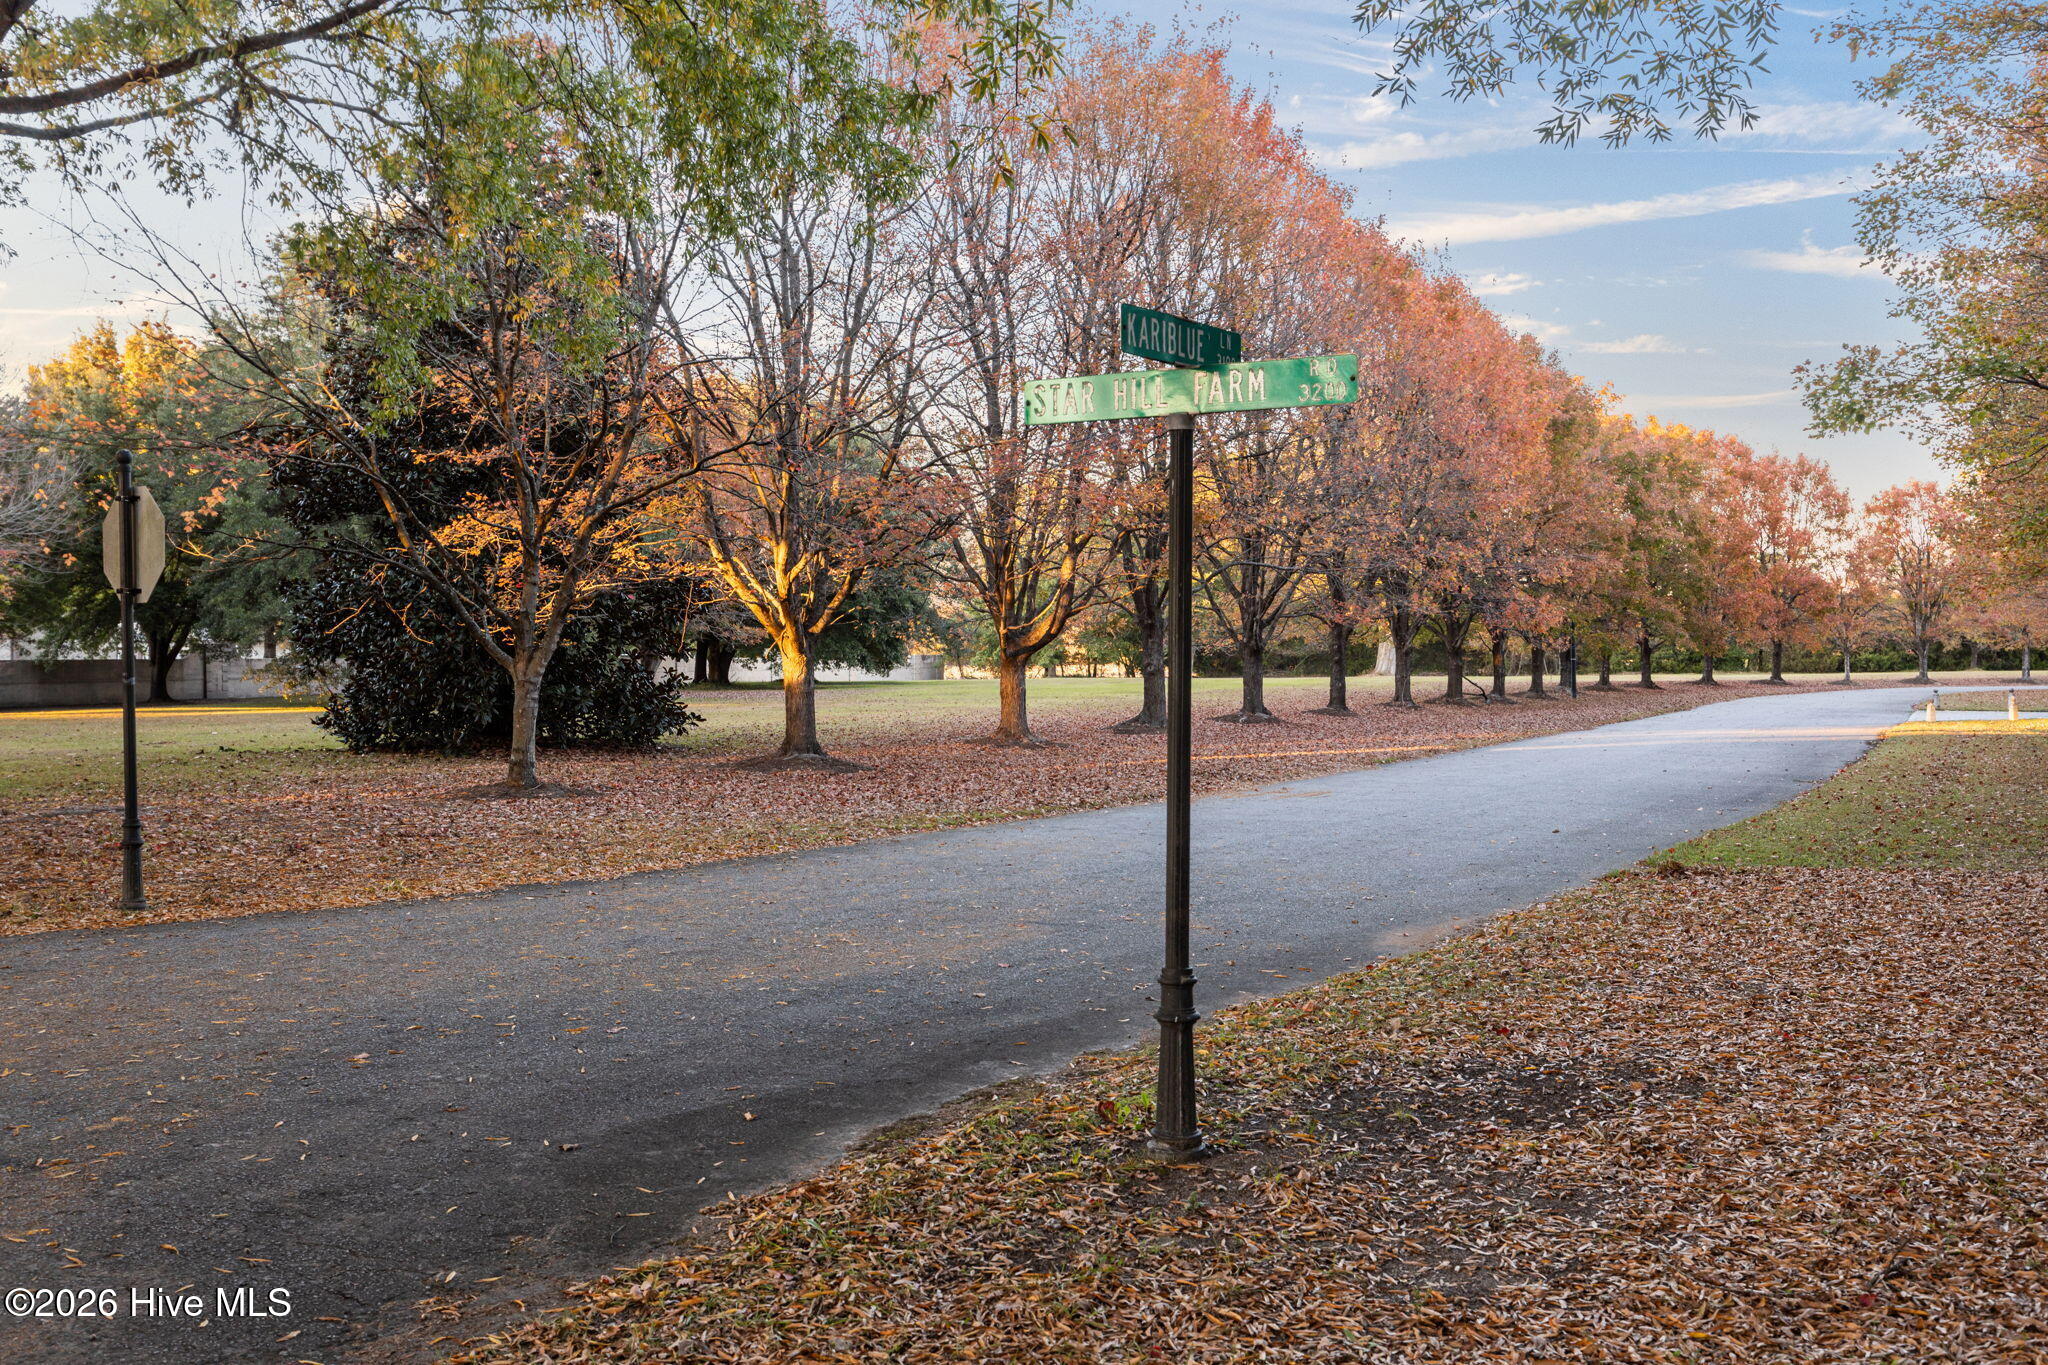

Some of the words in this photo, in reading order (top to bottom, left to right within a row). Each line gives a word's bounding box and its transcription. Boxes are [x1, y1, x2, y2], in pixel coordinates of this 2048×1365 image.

[1127, 312, 1205, 362] KARIBLUE
[1220, 331, 1232, 350] LN
[1310, 358, 1338, 377] RD
[1033, 381, 1096, 417] STAR
[1113, 375, 1169, 411] HILL
[1193, 367, 1267, 406] FARM
[1298, 381, 1347, 402] 3200
